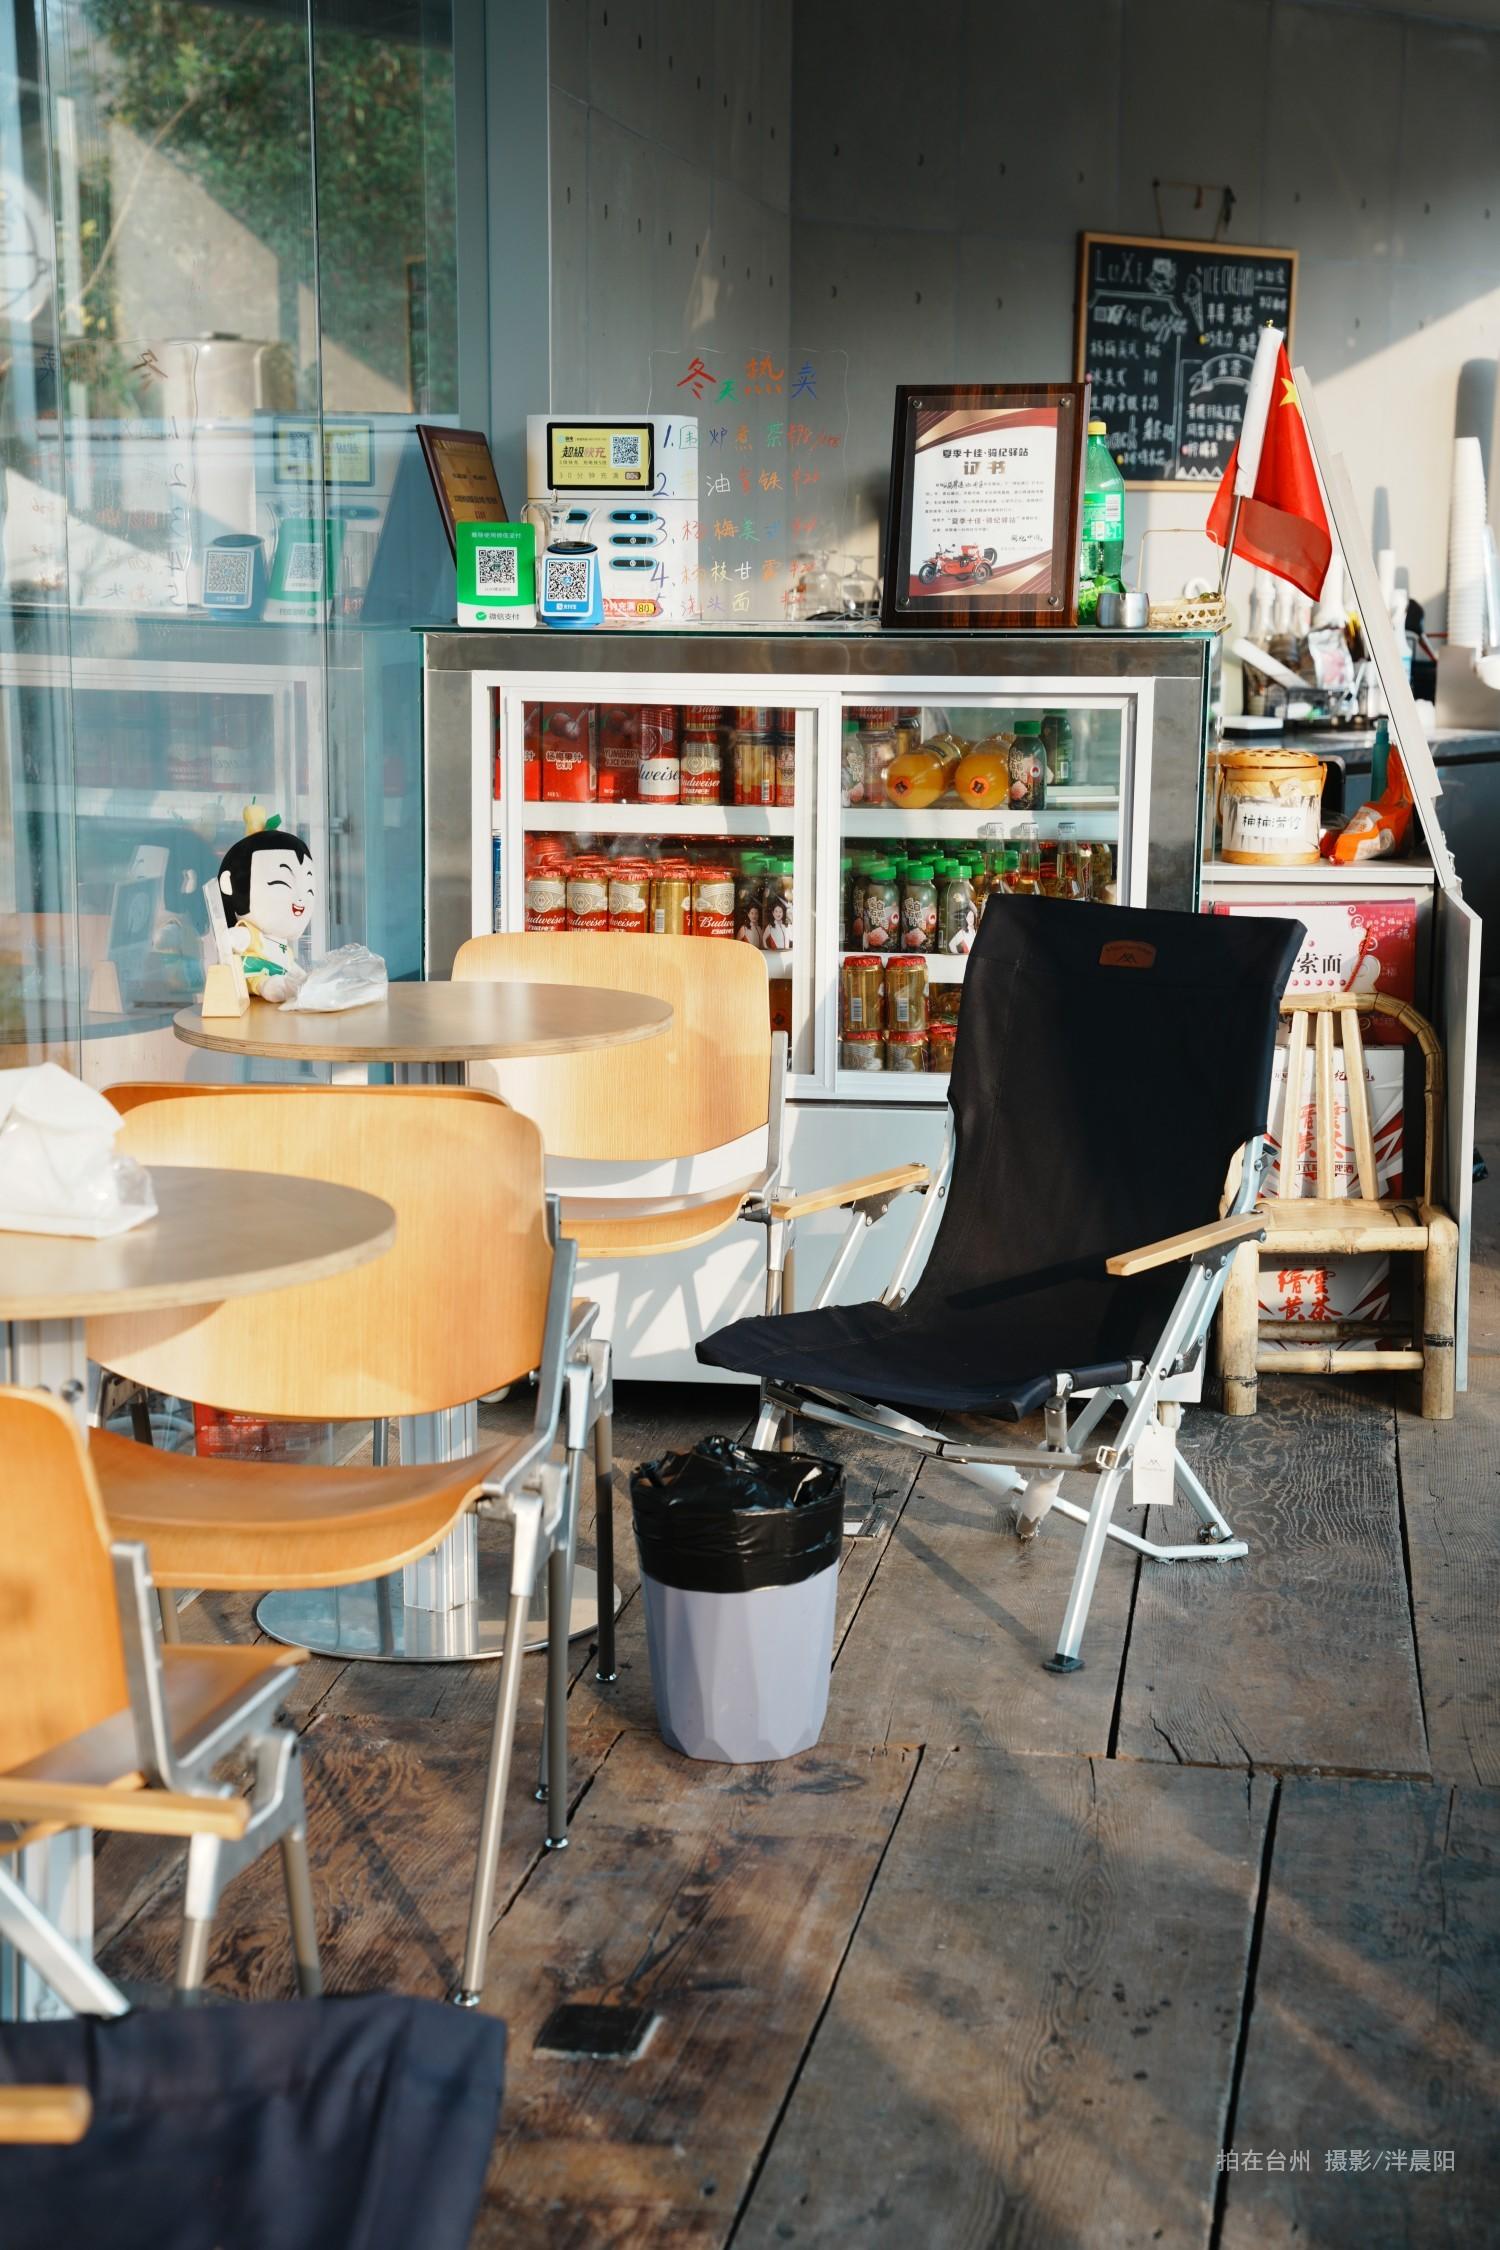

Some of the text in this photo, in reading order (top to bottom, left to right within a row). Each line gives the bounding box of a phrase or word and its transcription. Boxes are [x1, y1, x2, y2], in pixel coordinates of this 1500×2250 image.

[677, 355, 818, 405] 冬天热卖
[489, 612, 520, 621] 微信支付
[1291, 952, 1342, 975] 索面
